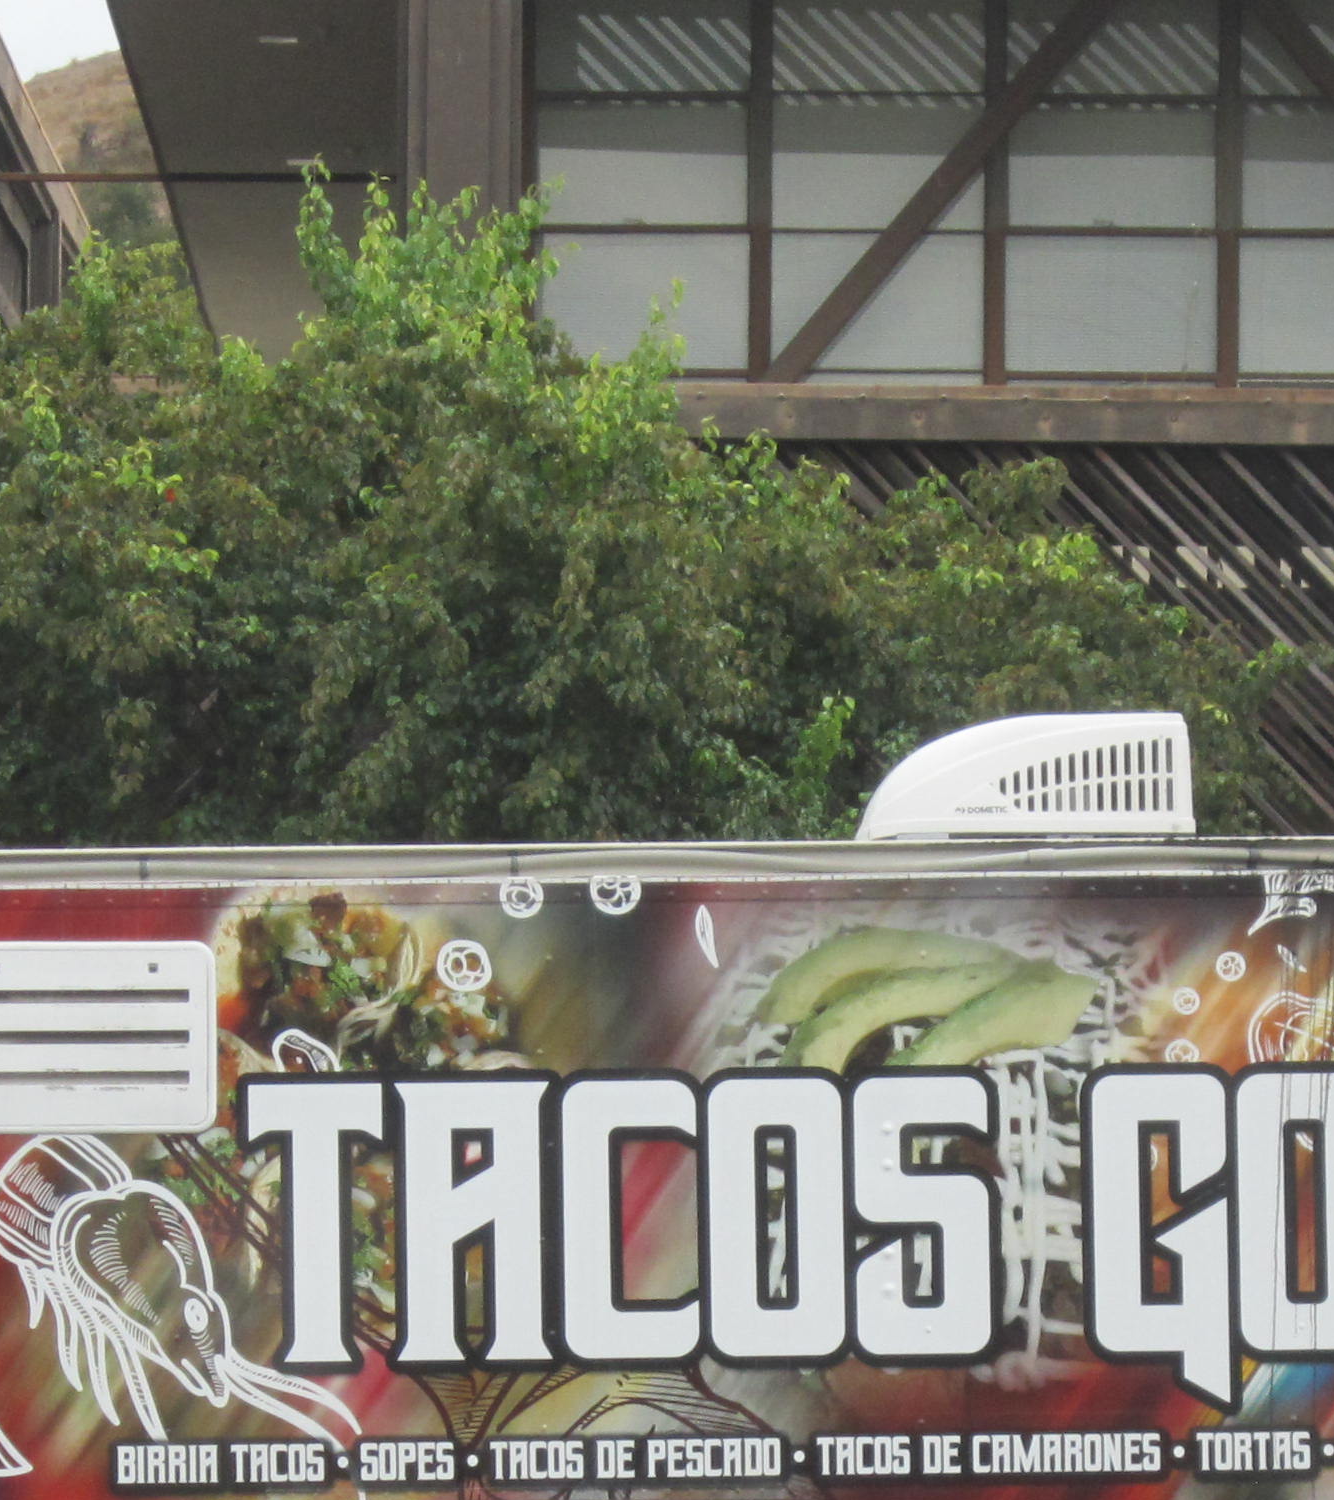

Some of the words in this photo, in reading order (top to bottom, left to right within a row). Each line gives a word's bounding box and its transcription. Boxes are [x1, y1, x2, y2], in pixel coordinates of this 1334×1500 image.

[967, 806, 1008, 814] DOMETIC
[247, 1075, 994, 1364] TACOS
[117, 1445, 218, 1484] BIRRIA
[230, 1444, 325, 1483] TACOS
[360, 1441, 455, 1481] SOPES
[489, 1440, 584, 1480] TACOS
[597, 1440, 636, 1478] DE
[647, 1437, 781, 1478] PESCADO
[816, 1436, 911, 1476] TACOS
[922, 1436, 962, 1474] DE
[972, 1432, 1161, 1474] CAMARONES
[1196, 1431, 1311, 1471] TORTAS
